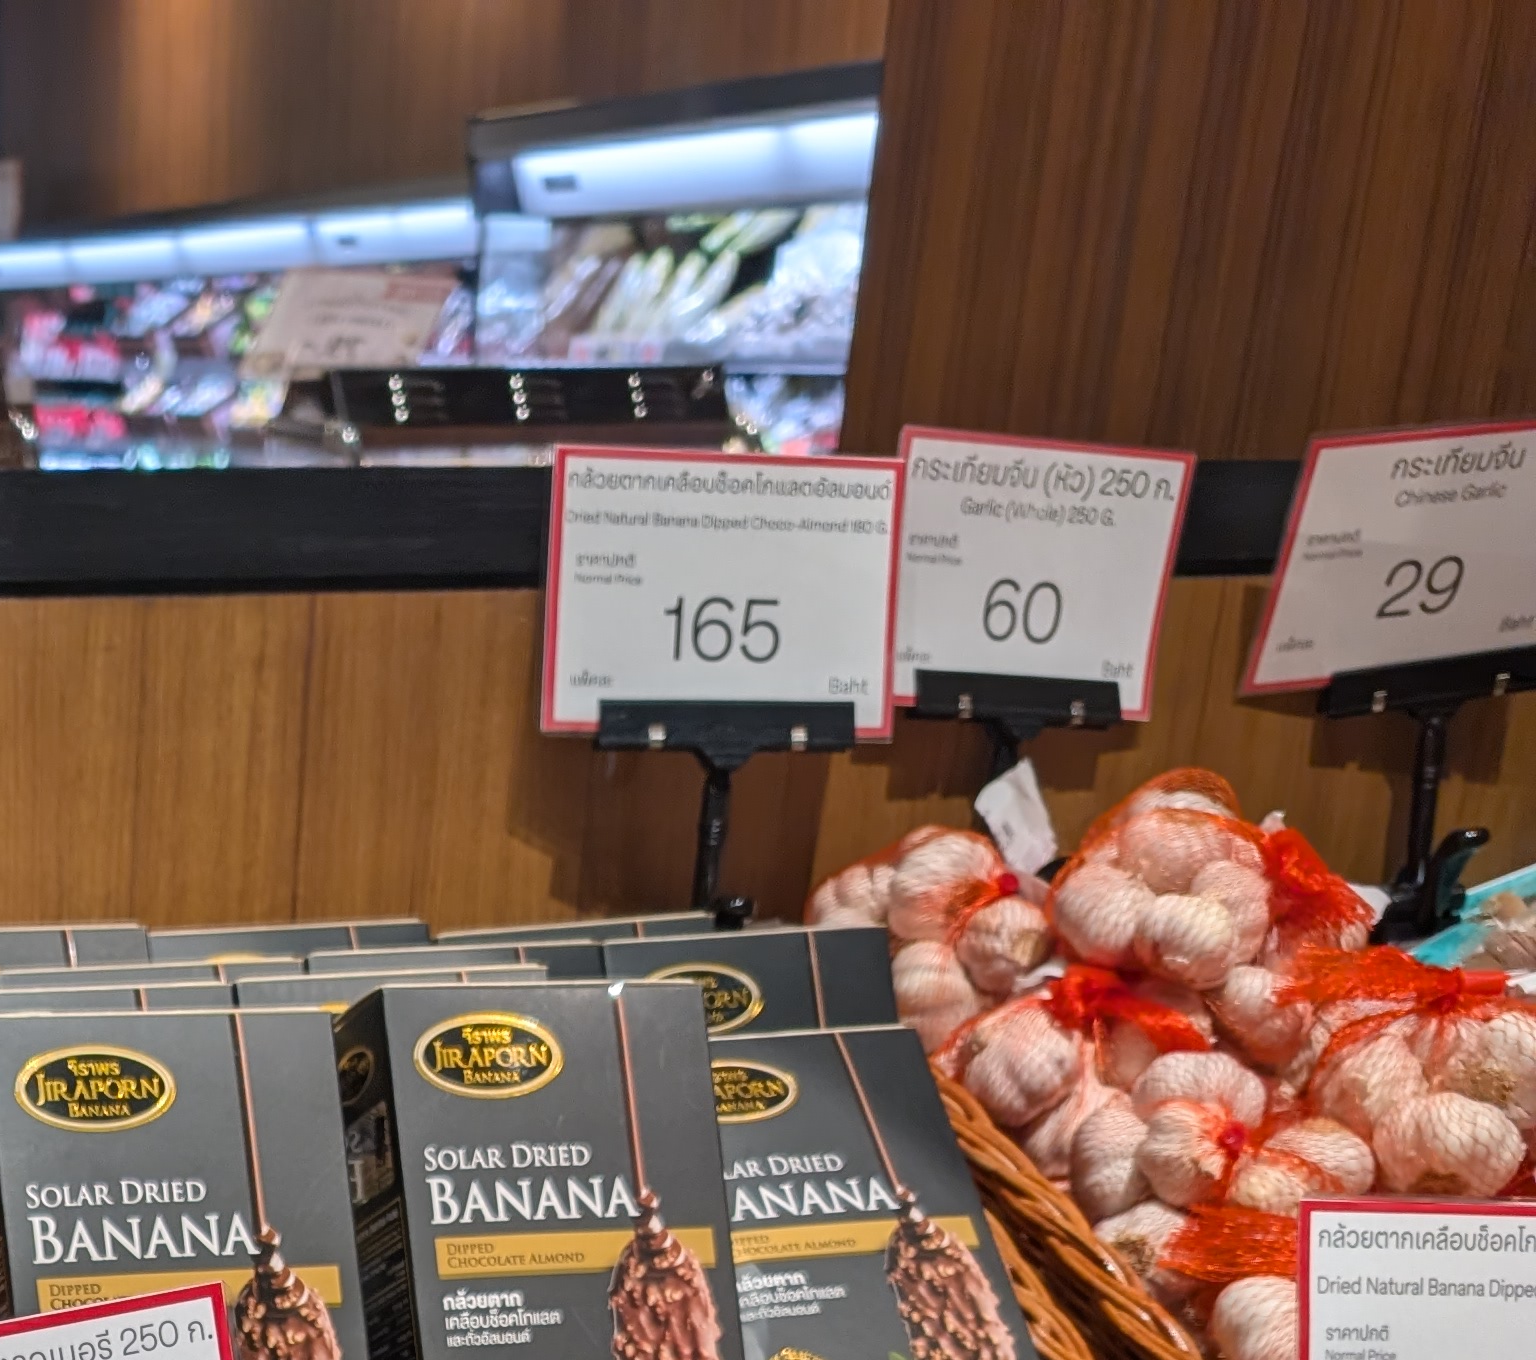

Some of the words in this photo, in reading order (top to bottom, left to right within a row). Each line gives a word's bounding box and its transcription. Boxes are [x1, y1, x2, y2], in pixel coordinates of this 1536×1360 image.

[1390, 441, 1527, 481] กระเทียมจีน
[1099, 467, 1151, 499] 250
[604, 511, 649, 527] Natural
[652, 512, 698, 529] Banana
[959, 496, 1002, 519] Garlic
[1067, 503, 1099, 526] 250
[1375, 554, 1465, 620] 29
[982, 577, 1063, 645] 60
[663, 595, 781, 664] 165
[1317, 1276, 1362, 1296] Dried
[1366, 1276, 1424, 1297] Natural
[1427, 1278, 1485, 1298] Banana
[1488, 1278, 1536, 1303] Dippe
[119, 1319, 179, 1357] 250
[187, 1319, 214, 1344] ก.
[1325, 1324, 1390, 1342] ราคาปกติ
